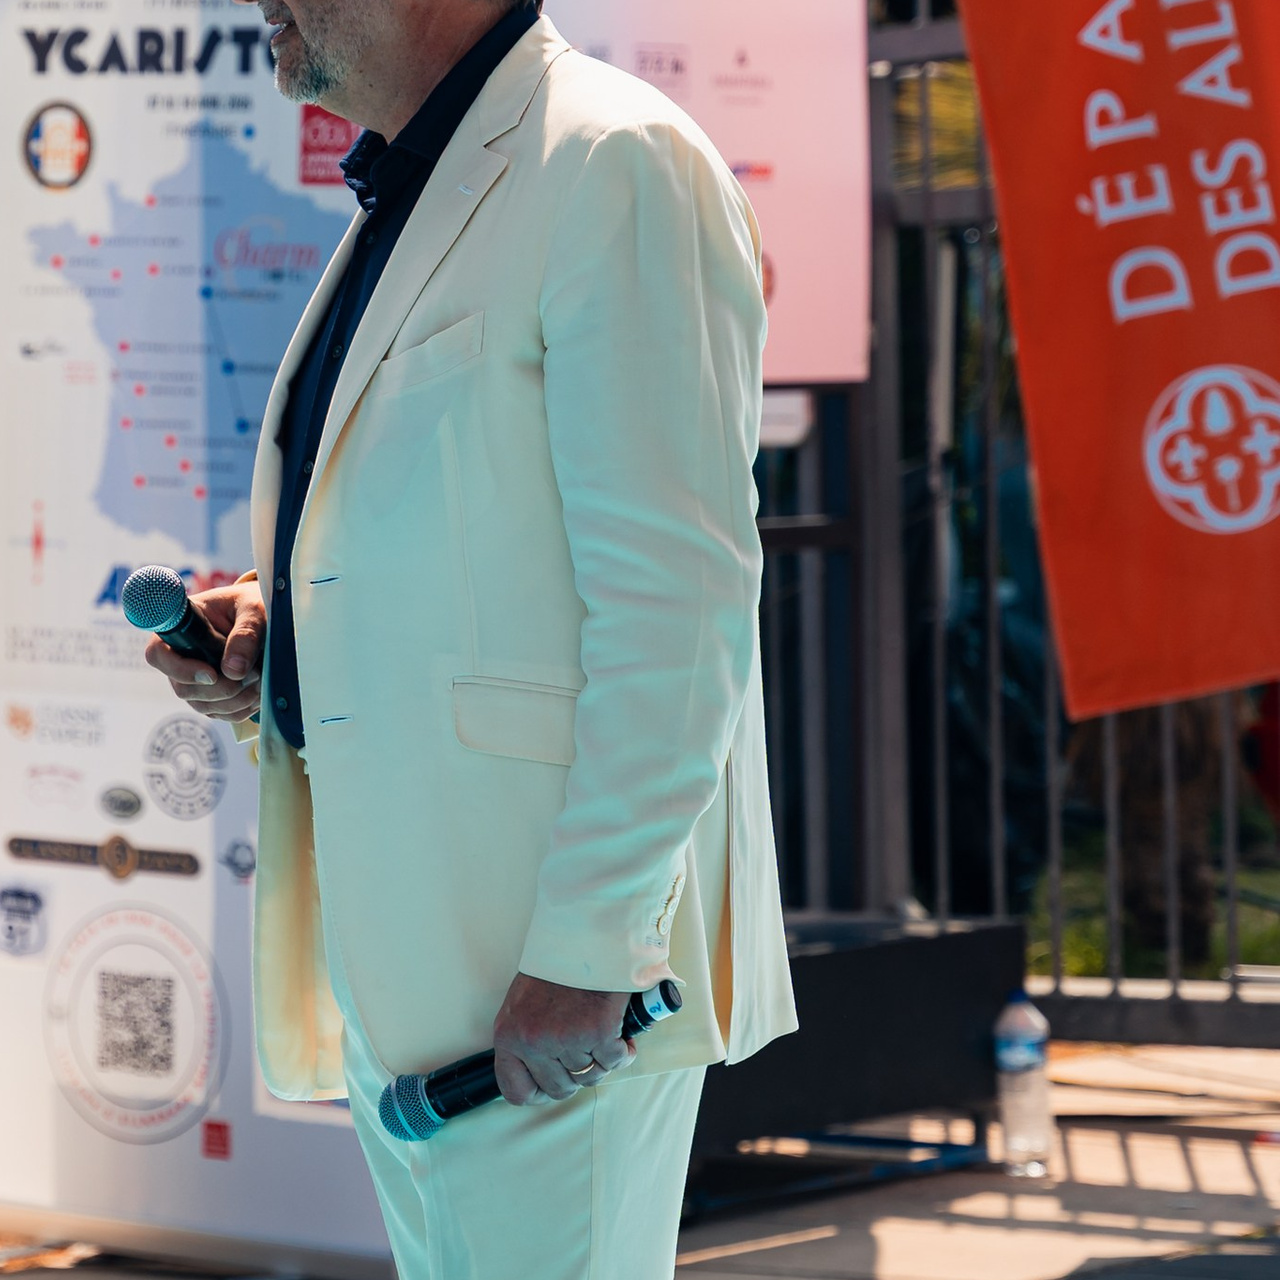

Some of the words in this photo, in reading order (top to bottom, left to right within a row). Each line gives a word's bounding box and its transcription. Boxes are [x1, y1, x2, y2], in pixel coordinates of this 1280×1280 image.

[21, 25, 280, 77] YCARIST
[1190, 138, 1280, 300] DES
[213, 224, 320, 271] Charm
